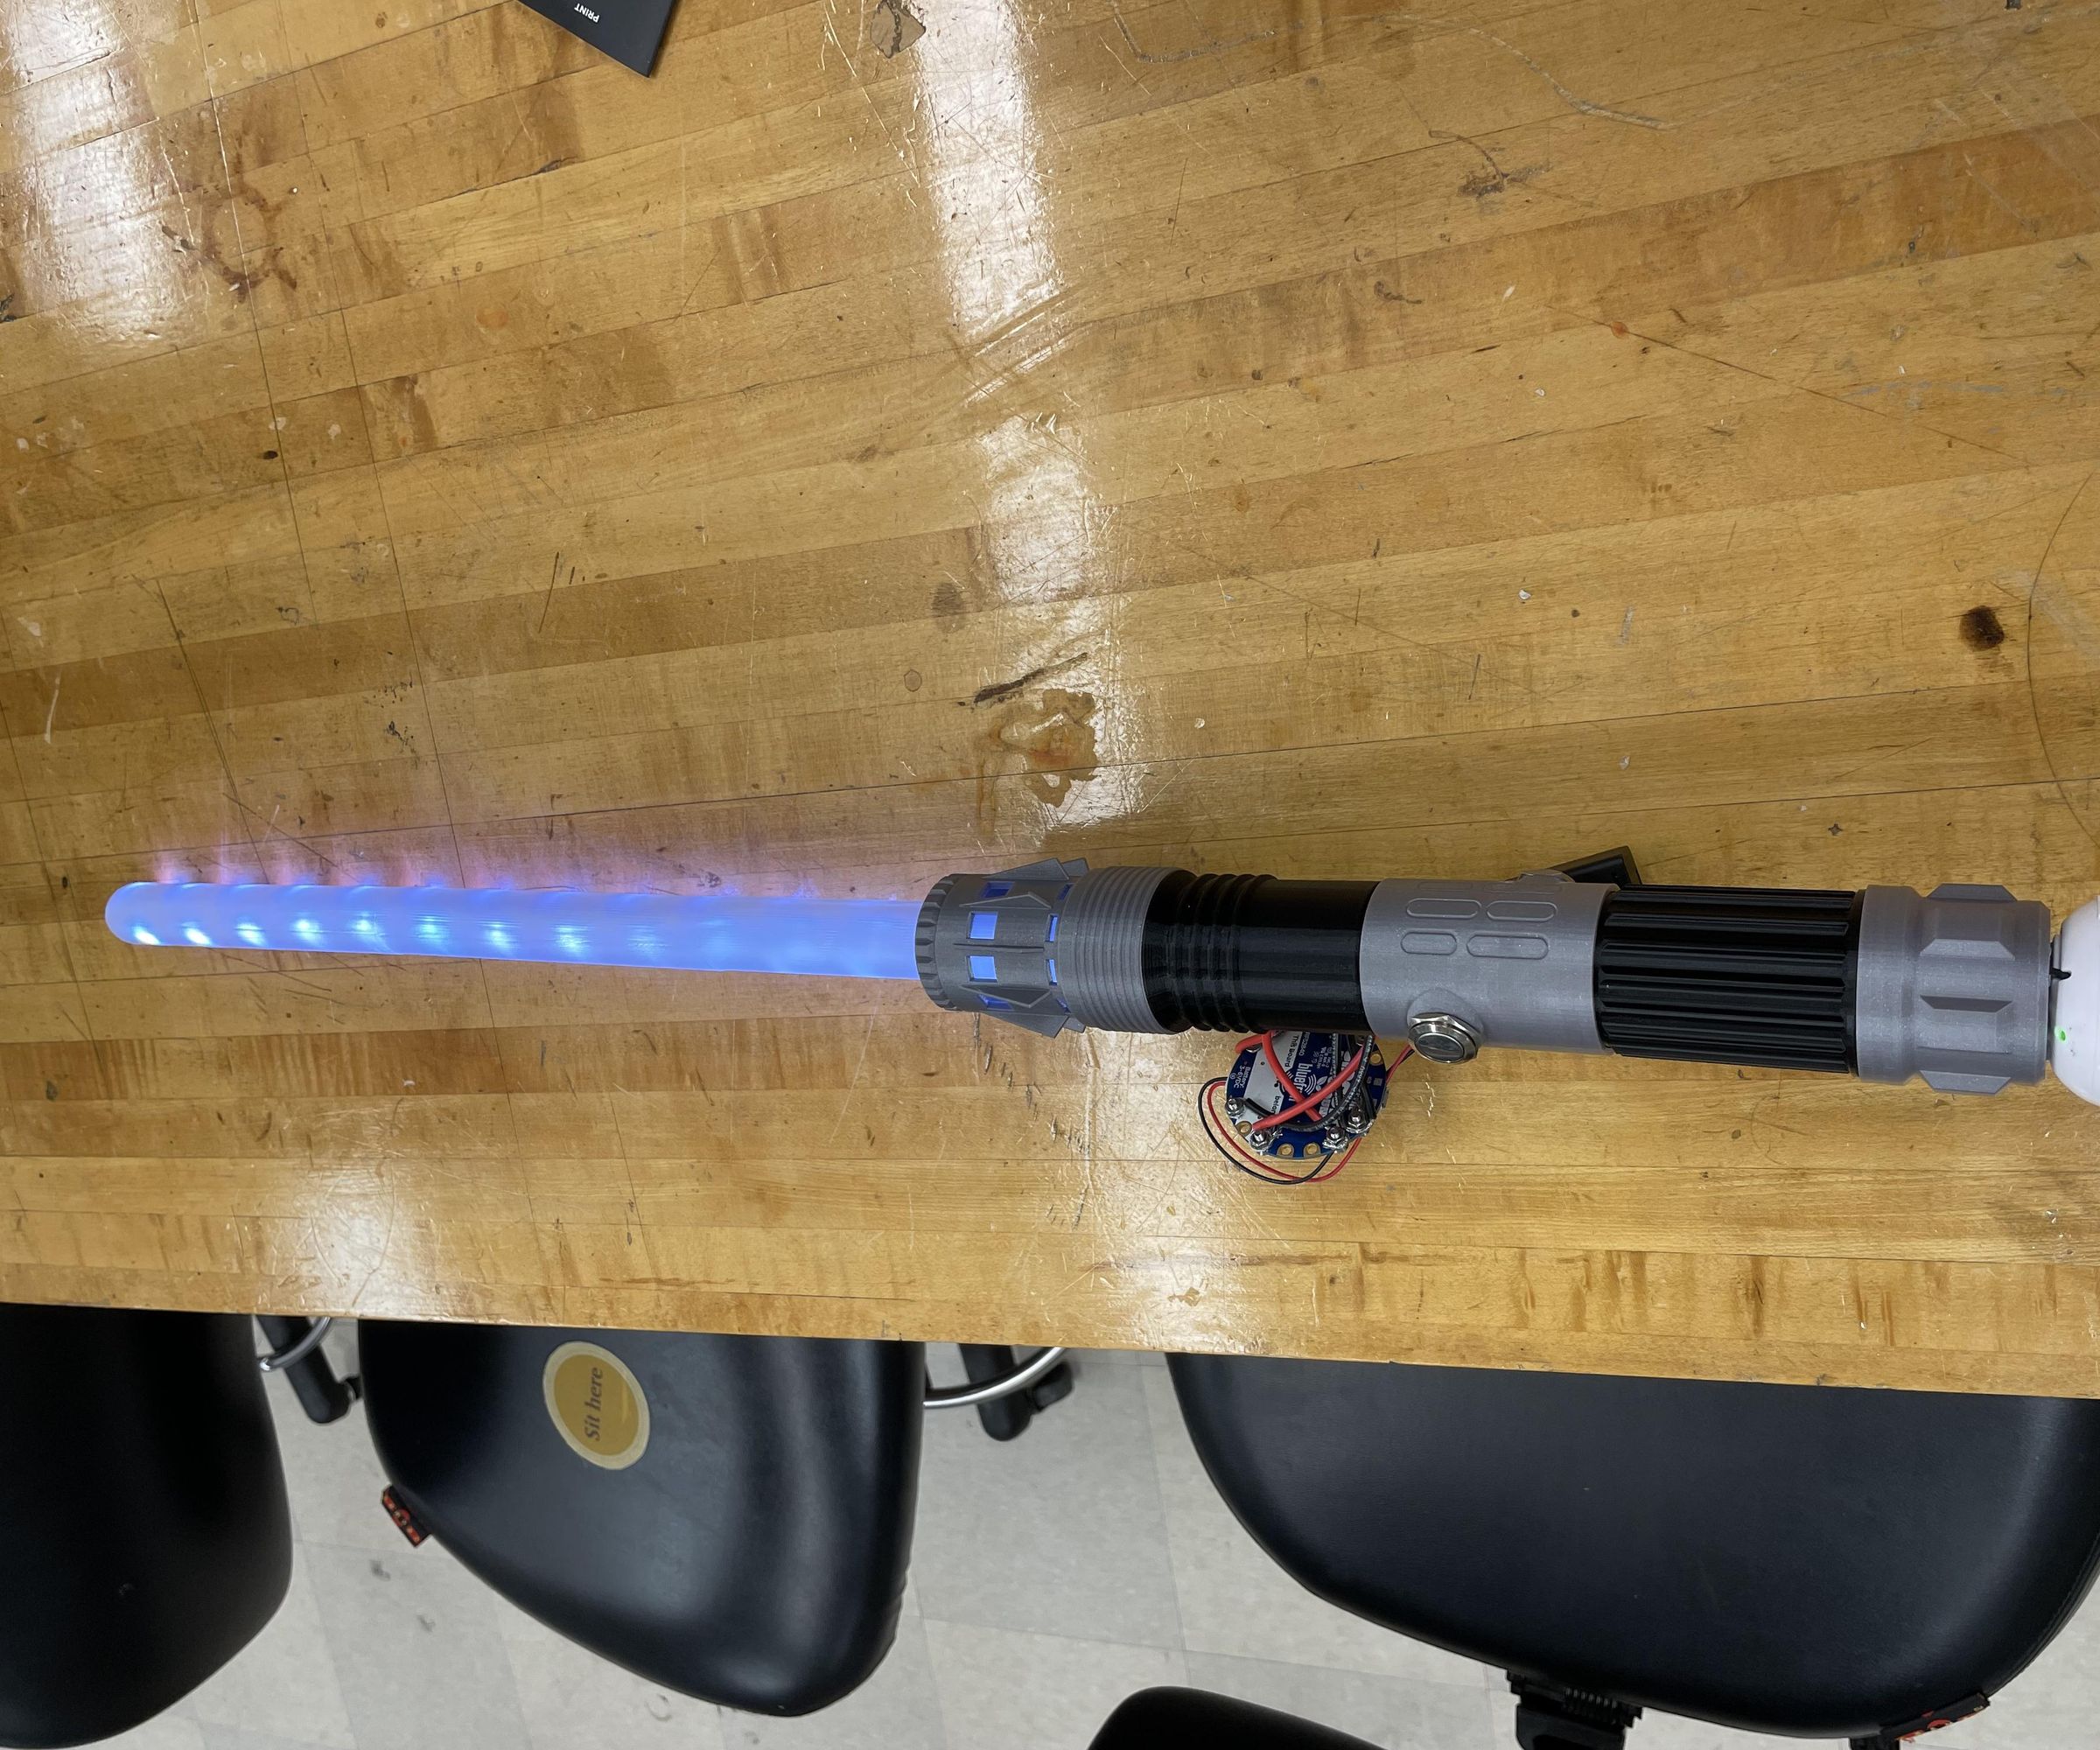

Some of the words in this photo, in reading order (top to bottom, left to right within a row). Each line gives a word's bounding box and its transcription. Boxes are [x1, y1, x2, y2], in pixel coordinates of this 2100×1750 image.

[574, 3, 599, 23] PRINT
[1284, 1048, 1295, 1068] Board
[584, 1367, 604, 1411] here
[584, 1414, 601, 1442] Sit
